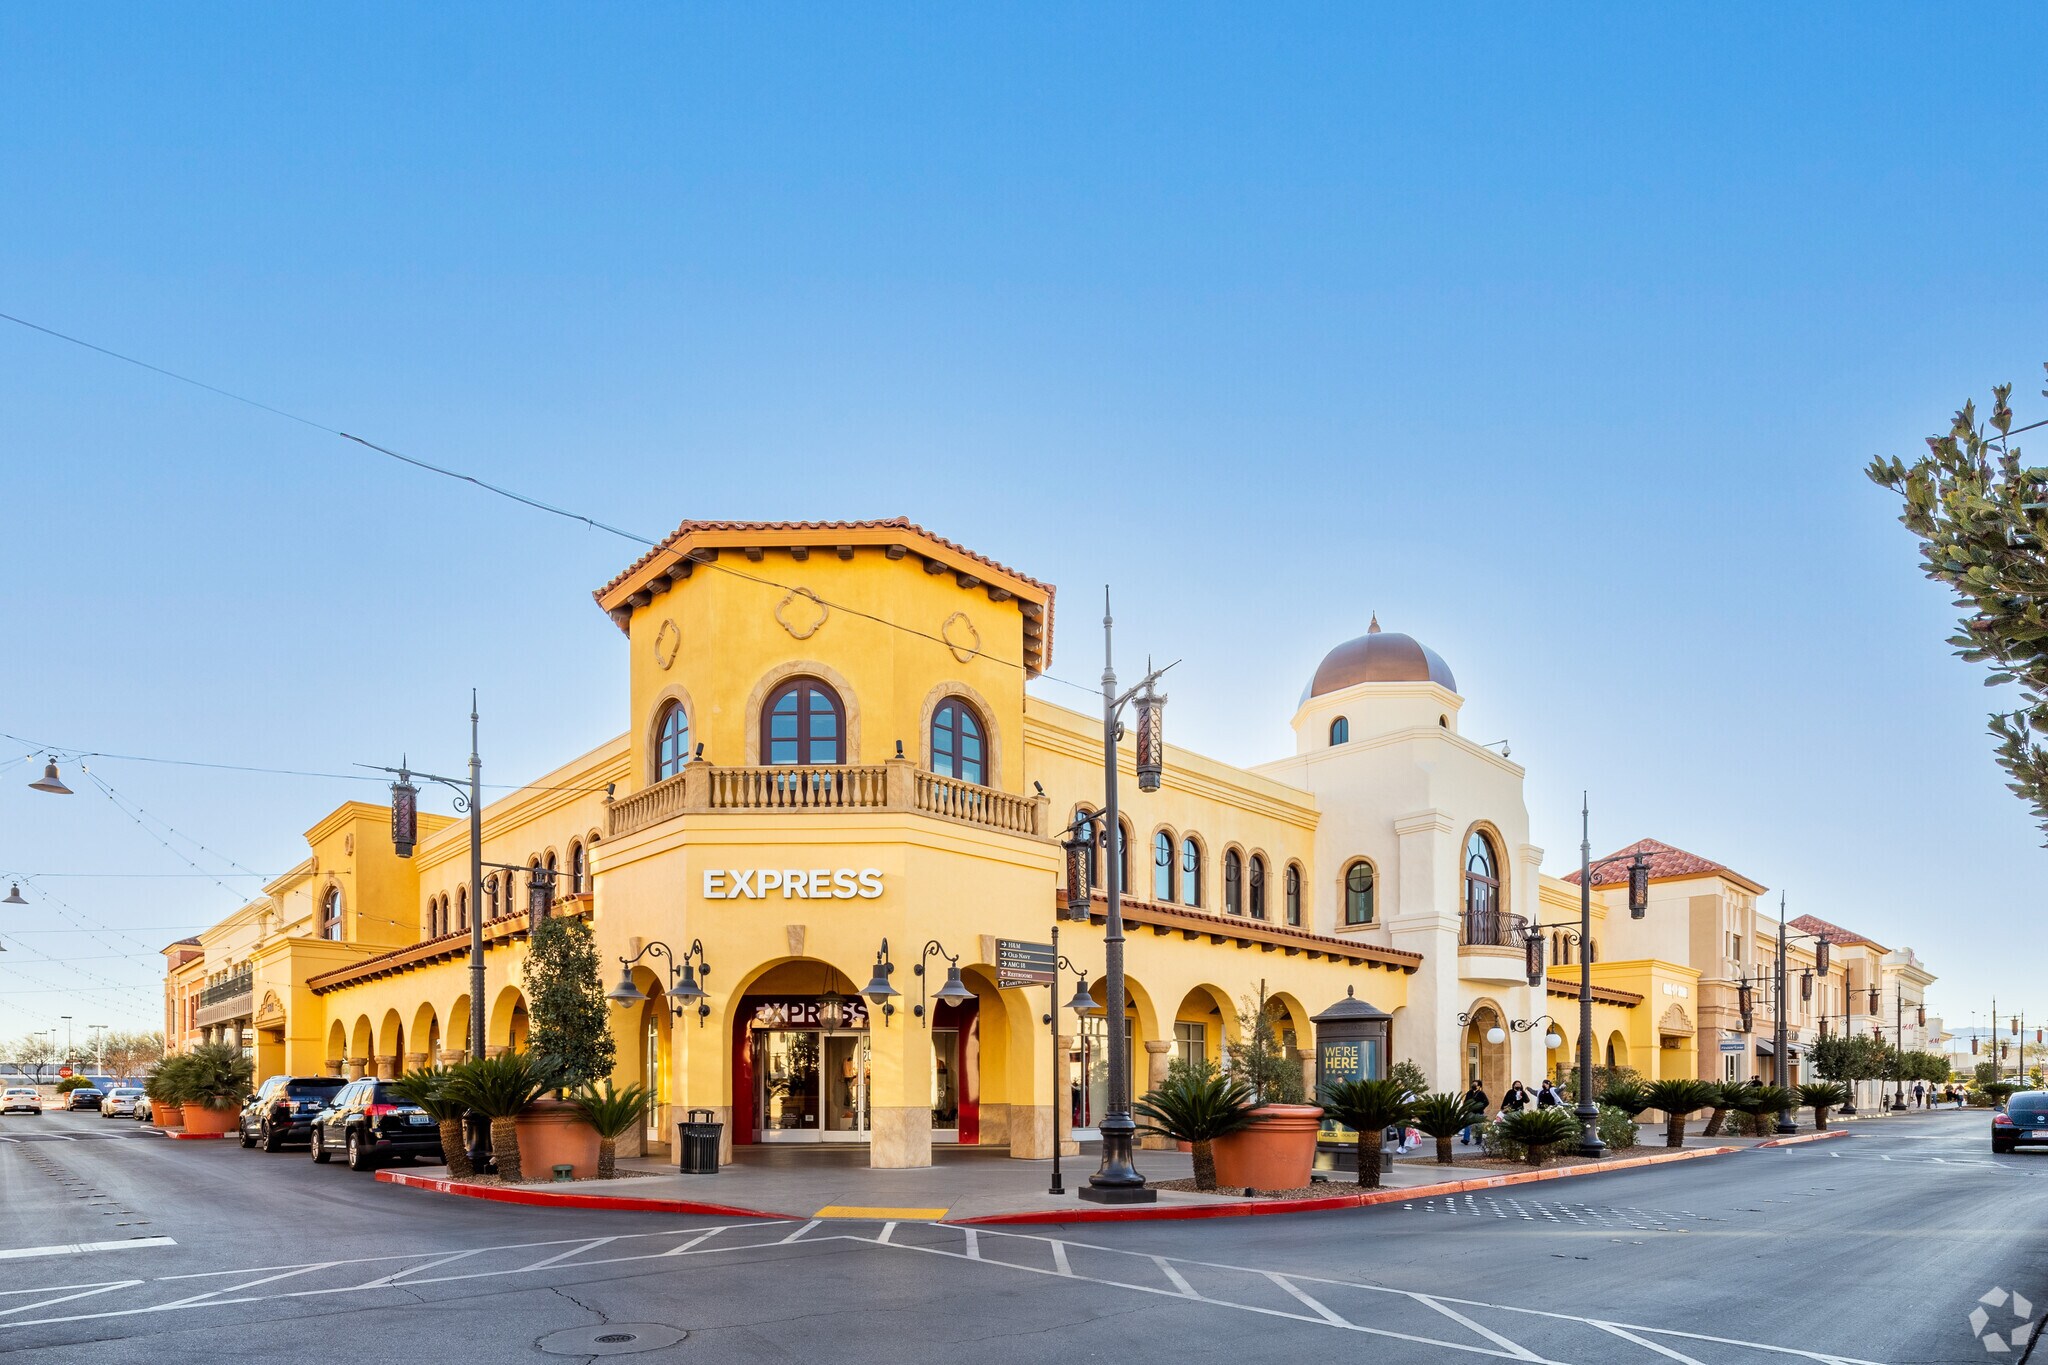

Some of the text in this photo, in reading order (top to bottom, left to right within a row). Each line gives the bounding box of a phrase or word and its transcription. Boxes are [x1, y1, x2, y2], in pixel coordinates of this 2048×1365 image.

[703, 868, 884, 899] EXPRESS
[752, 1003, 869, 1023] EXPRSS
[1325, 1046, 1359, 1057] WE'RE
[1325, 1057, 1359, 1069] HERE
